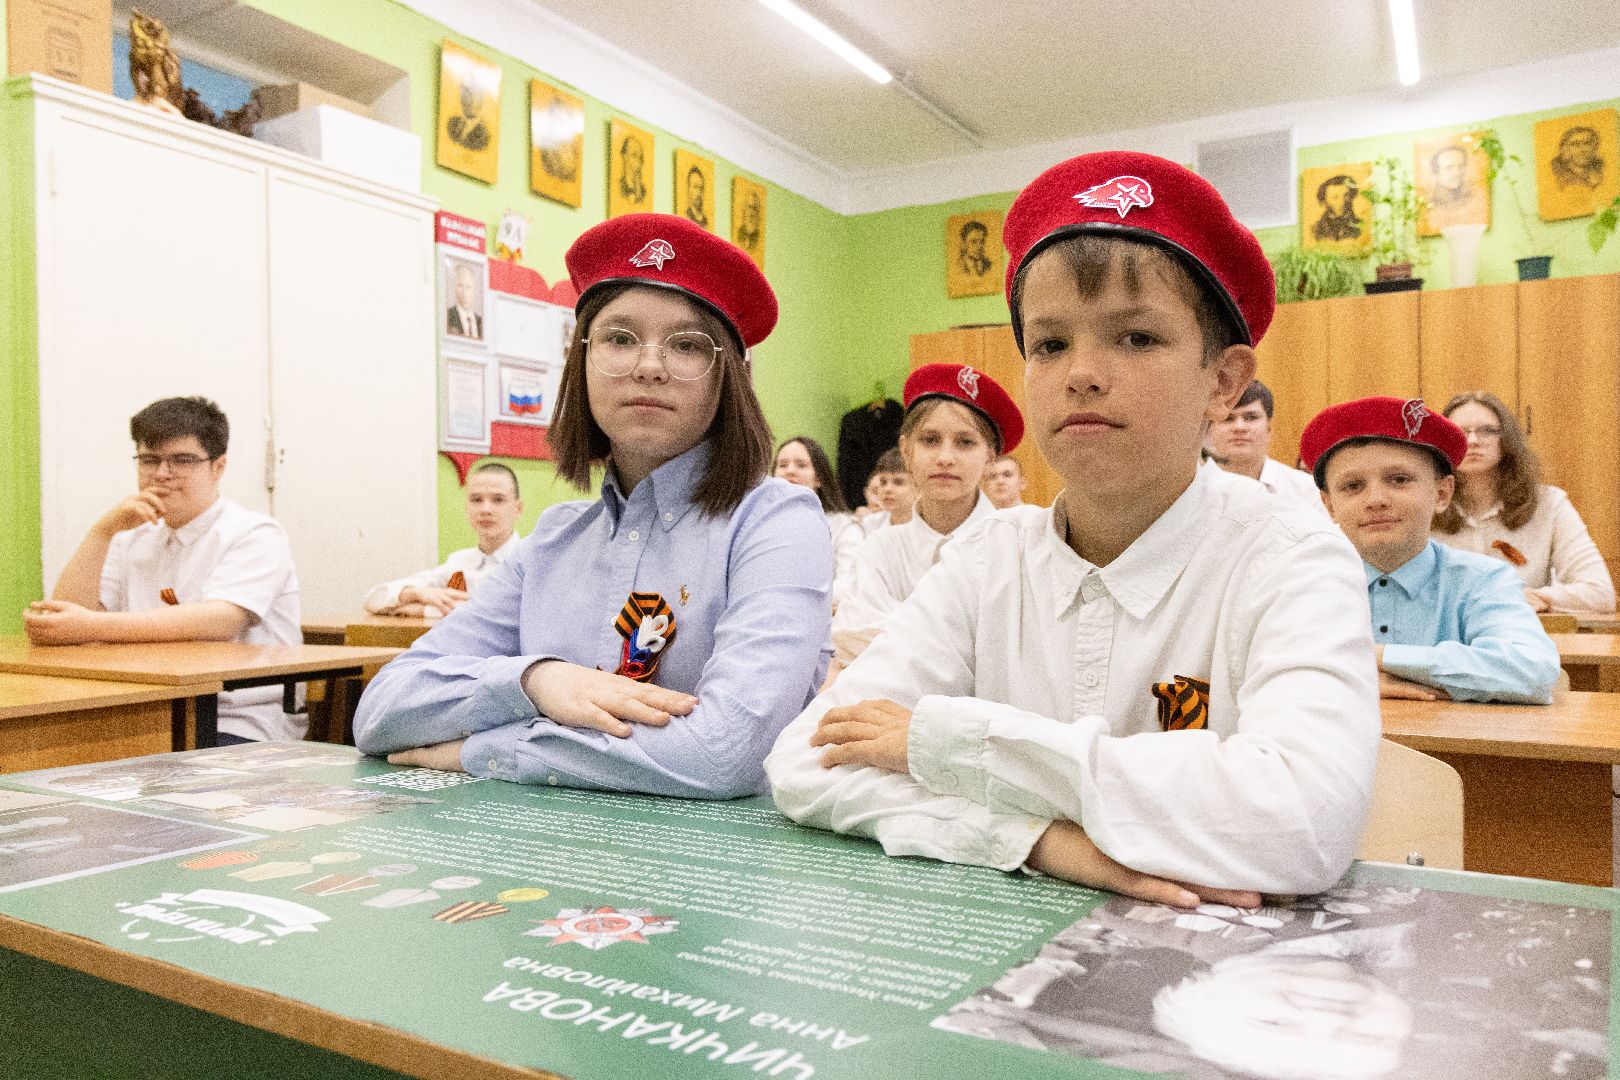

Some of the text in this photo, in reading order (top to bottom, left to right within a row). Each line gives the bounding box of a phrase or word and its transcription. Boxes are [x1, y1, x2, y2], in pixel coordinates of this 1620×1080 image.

[482, 981, 815, 1080] ЧИЧКАНОВА
[503, 956, 870, 1050] Анна Михайловна
